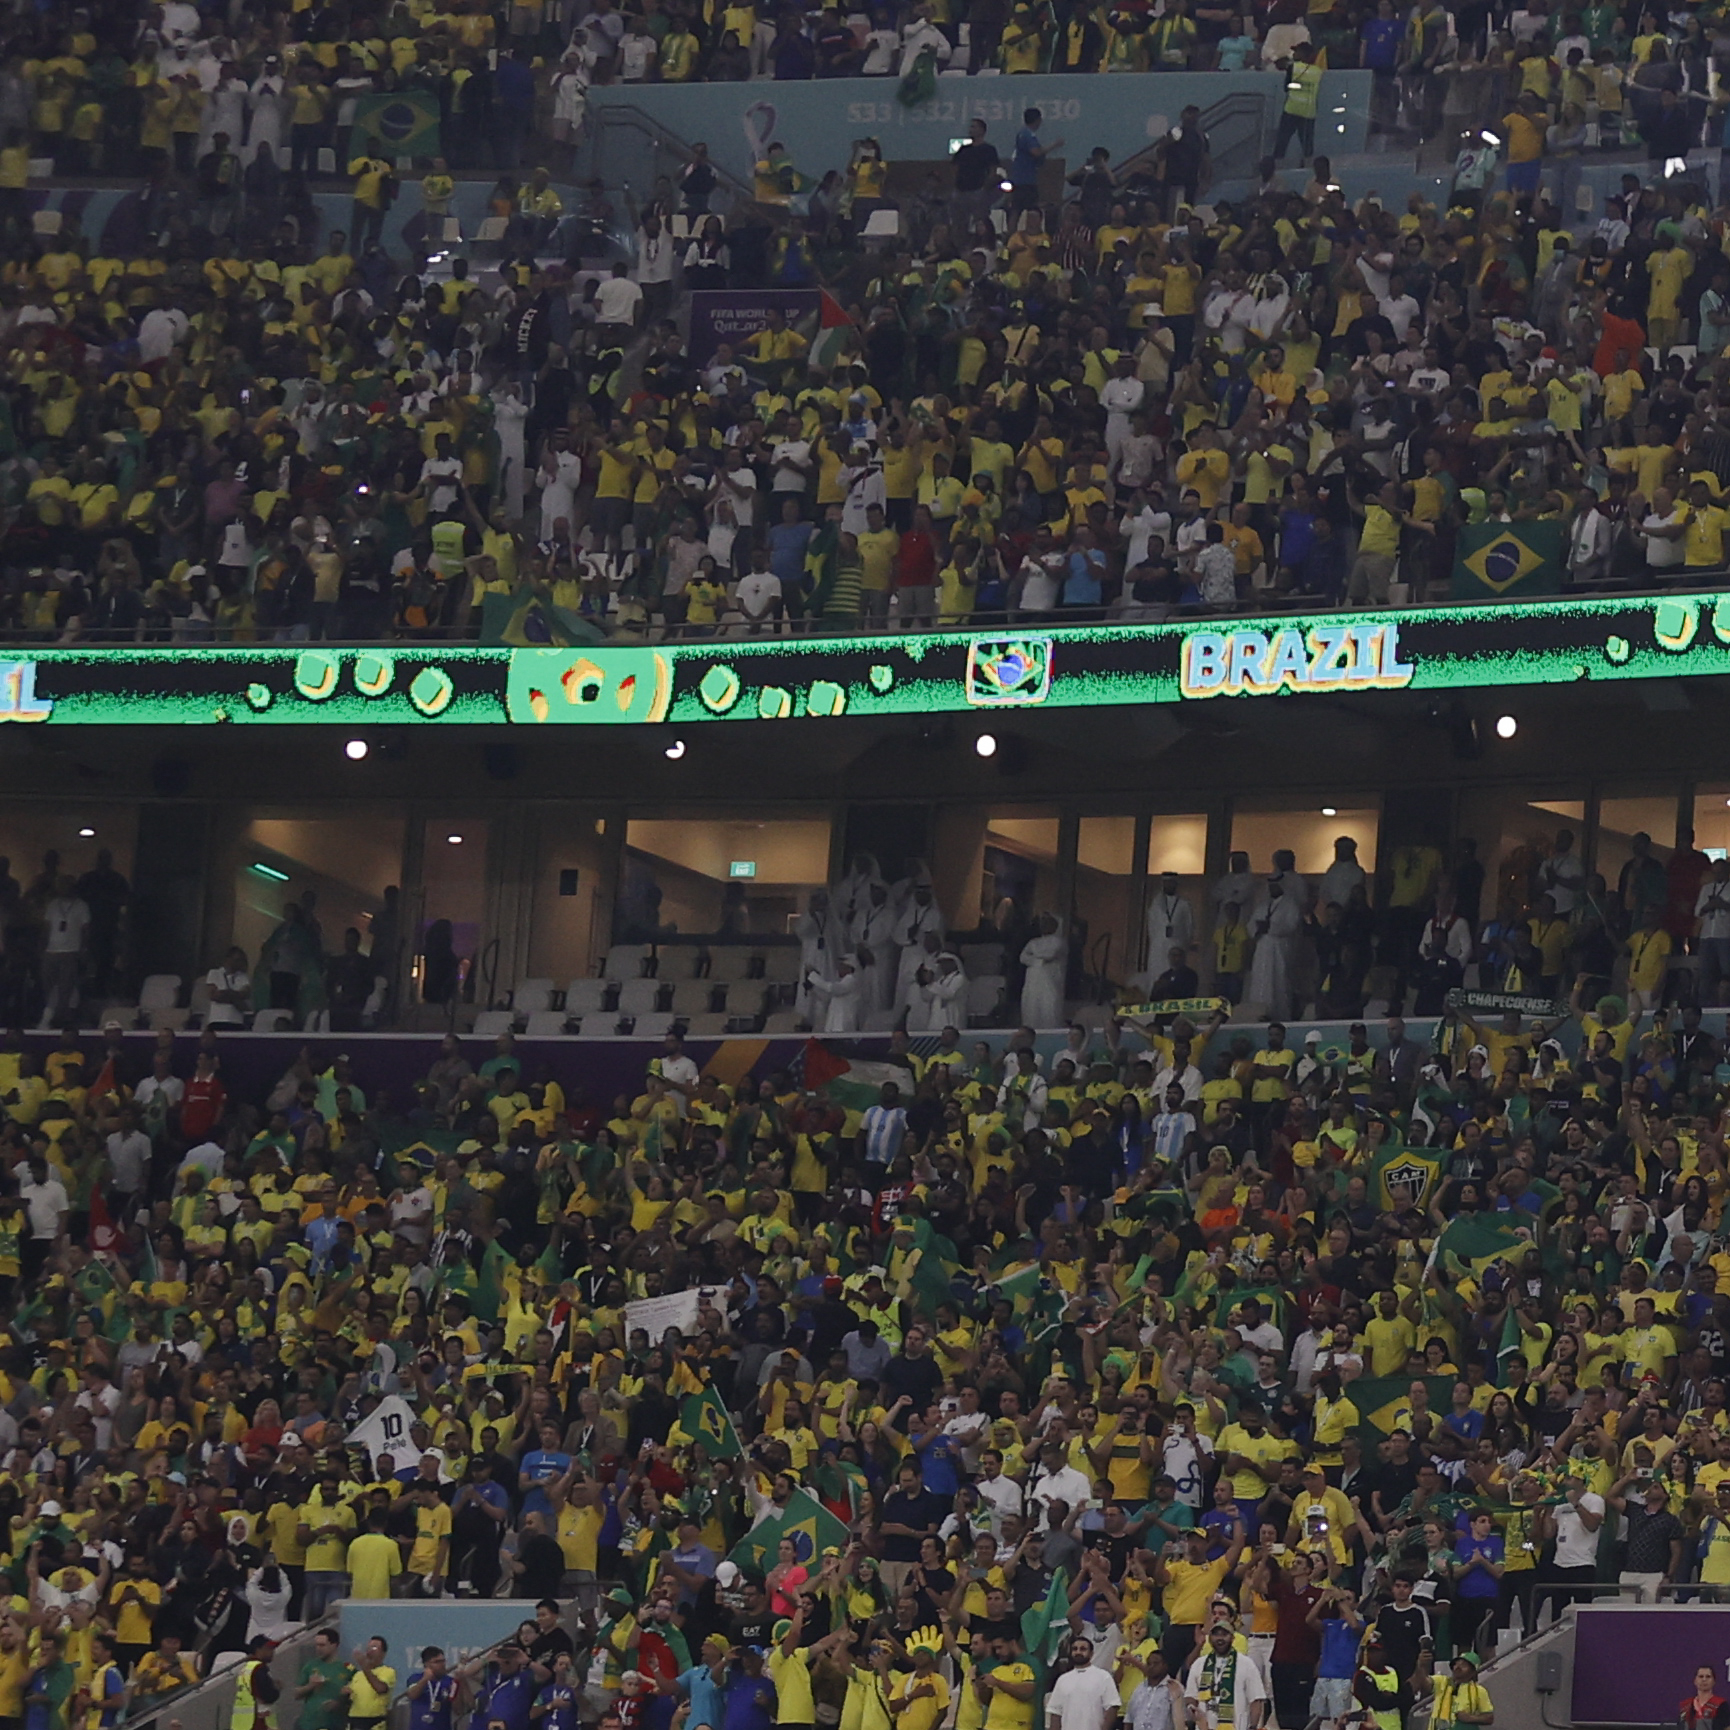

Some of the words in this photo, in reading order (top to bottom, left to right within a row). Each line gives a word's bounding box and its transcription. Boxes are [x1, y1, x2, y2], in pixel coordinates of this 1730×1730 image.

[1187, 624, 1413, 692] BRAZIL
[1466, 992, 1553, 1012] CHAPECOENSE
[381, 1413, 402, 1440] 10
